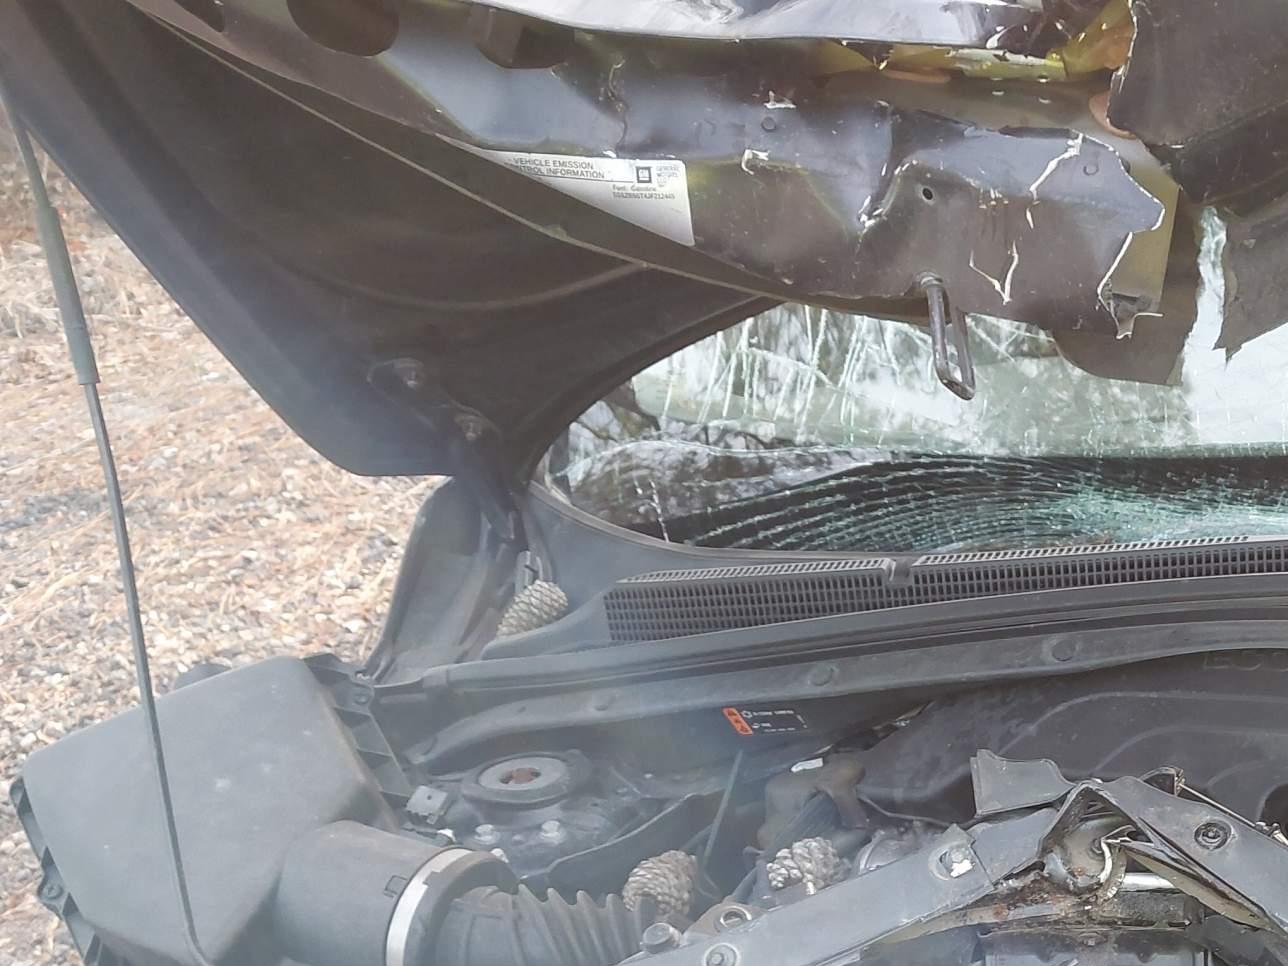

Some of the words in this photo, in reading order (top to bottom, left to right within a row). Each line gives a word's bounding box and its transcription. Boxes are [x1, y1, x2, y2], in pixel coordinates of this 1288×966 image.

[513, 157, 549, 167] VEHICLE
[553, 160, 594, 170] EMISSION
[546, 168, 605, 179] INFORMATION
